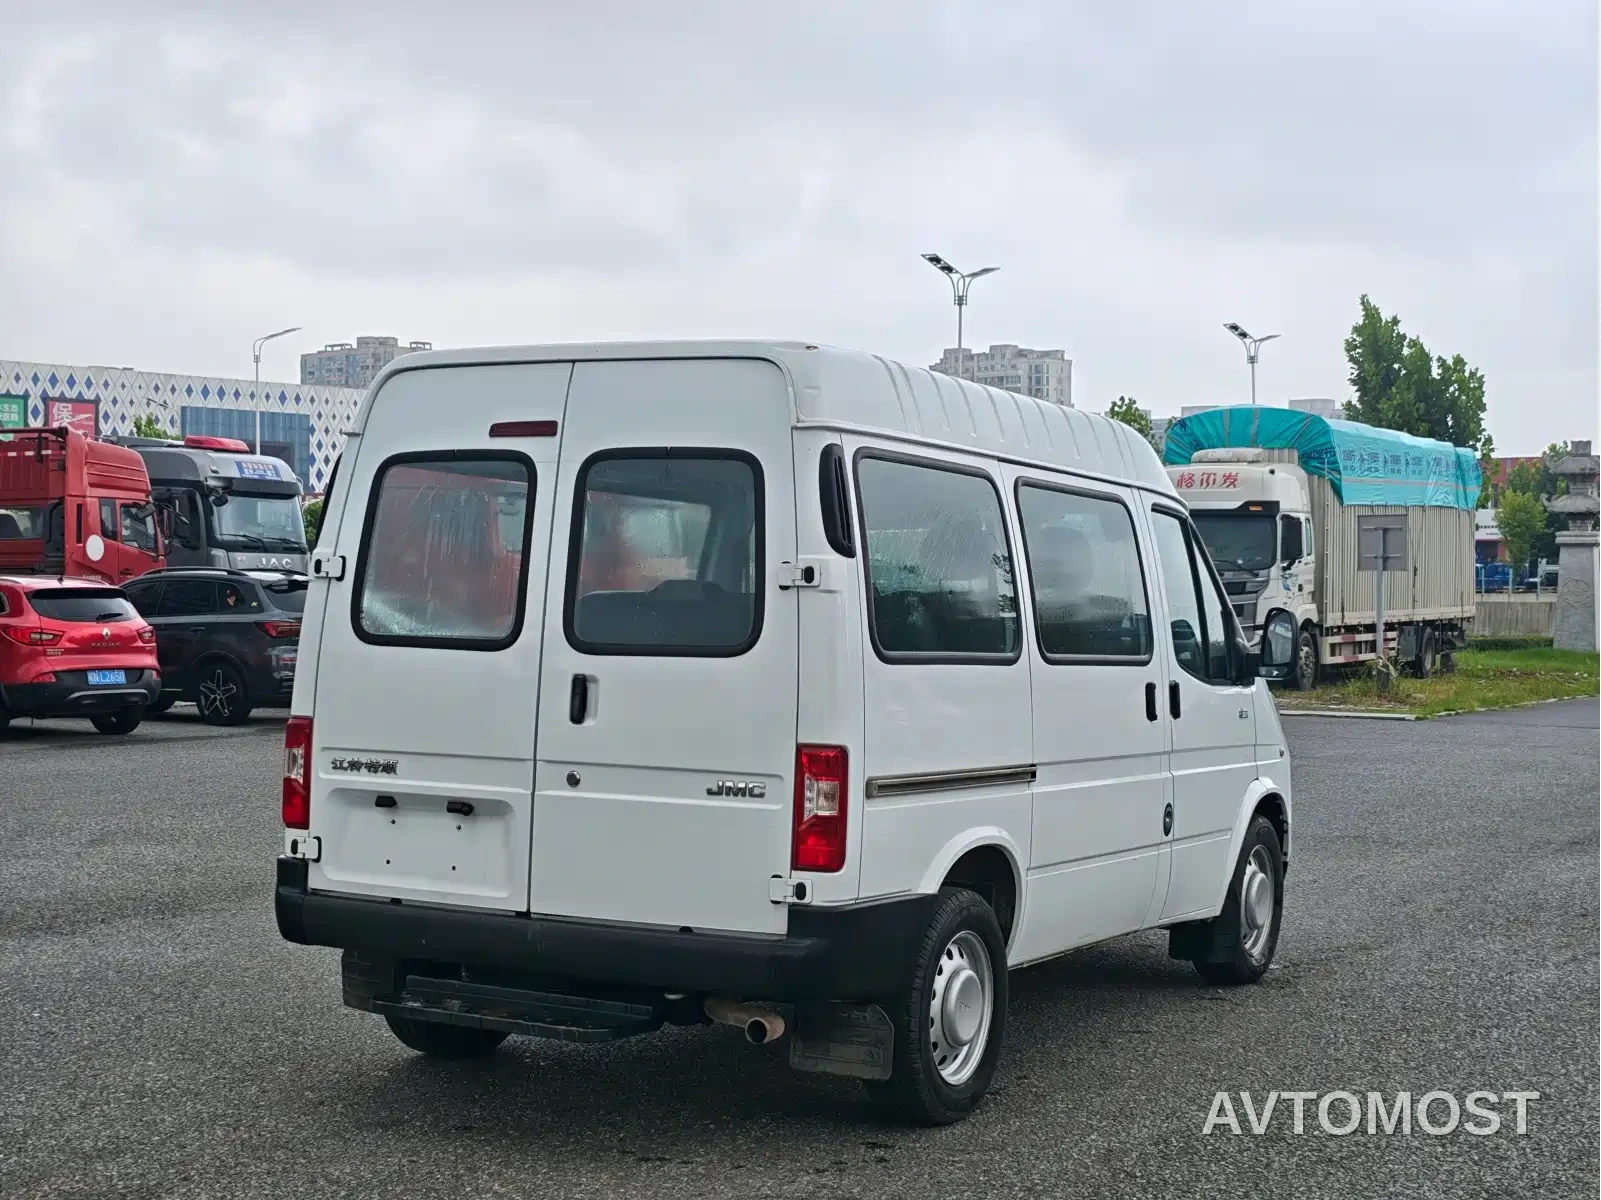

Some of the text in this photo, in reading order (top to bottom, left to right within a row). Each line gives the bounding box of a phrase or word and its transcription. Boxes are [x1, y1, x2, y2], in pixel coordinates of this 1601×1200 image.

[1176, 472, 1239, 490] 格尔发
[256, 557, 293, 569] JAC
[331, 757, 398, 775] 江铃特顺
[706, 780, 766, 798] JMC
